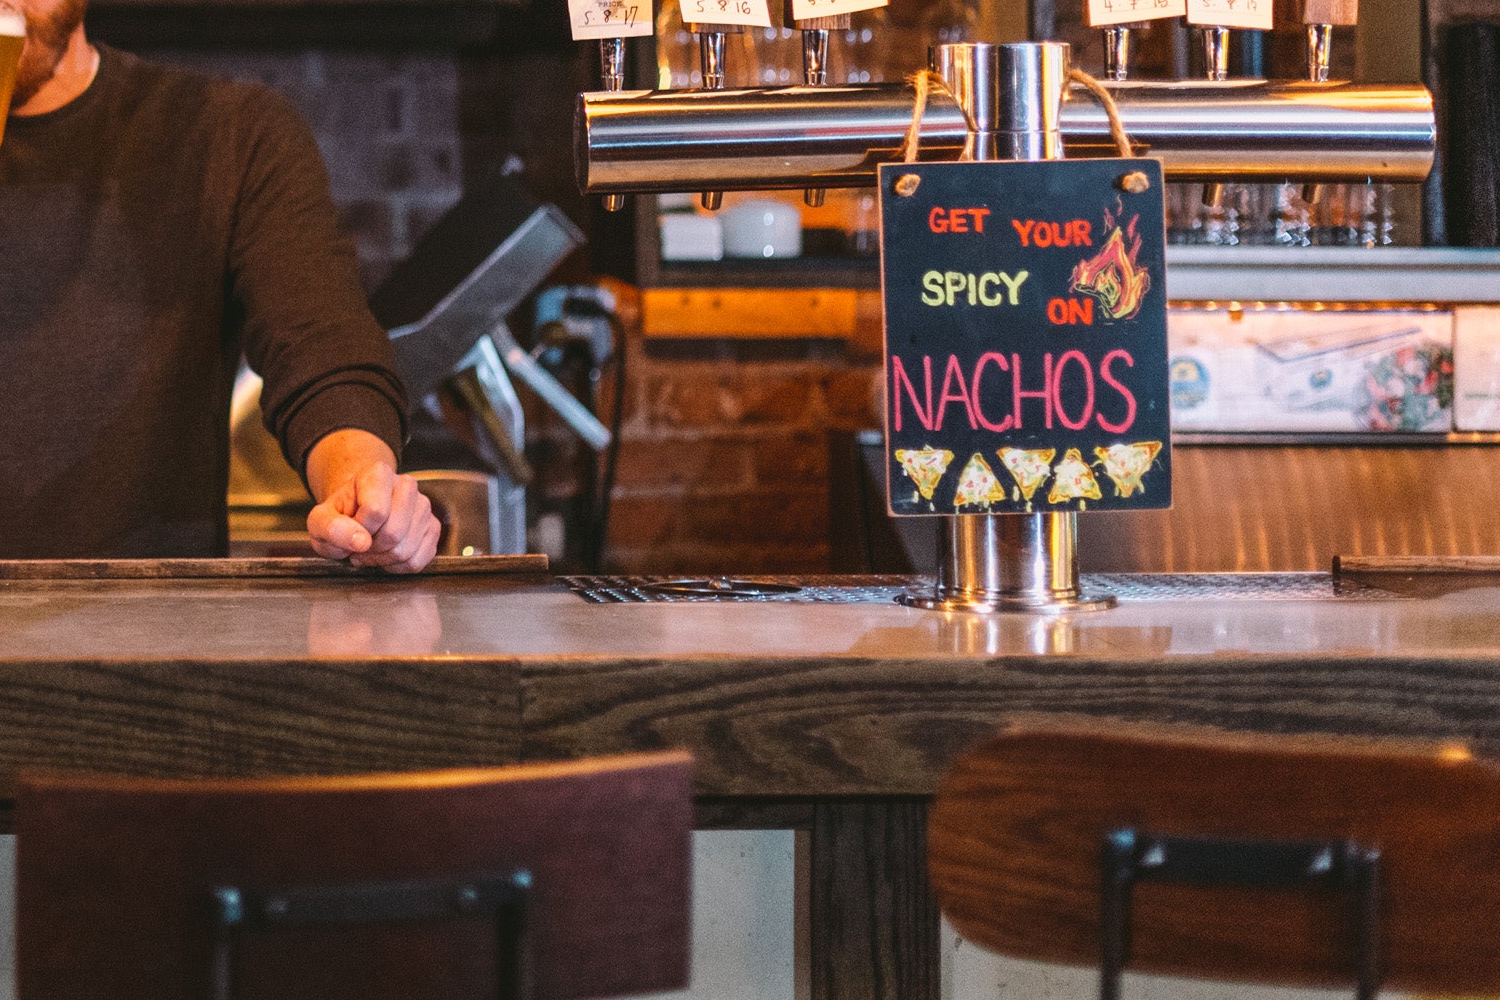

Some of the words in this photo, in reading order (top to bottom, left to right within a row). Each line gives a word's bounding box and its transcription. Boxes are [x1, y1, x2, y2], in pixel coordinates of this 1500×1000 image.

[929, 206, 991, 233] GET
[1012, 219, 1092, 247] YOUR
[921, 270, 1029, 306] SPICY
[1047, 298, 1093, 325] ON
[892, 350, 1137, 434] NACHOS
